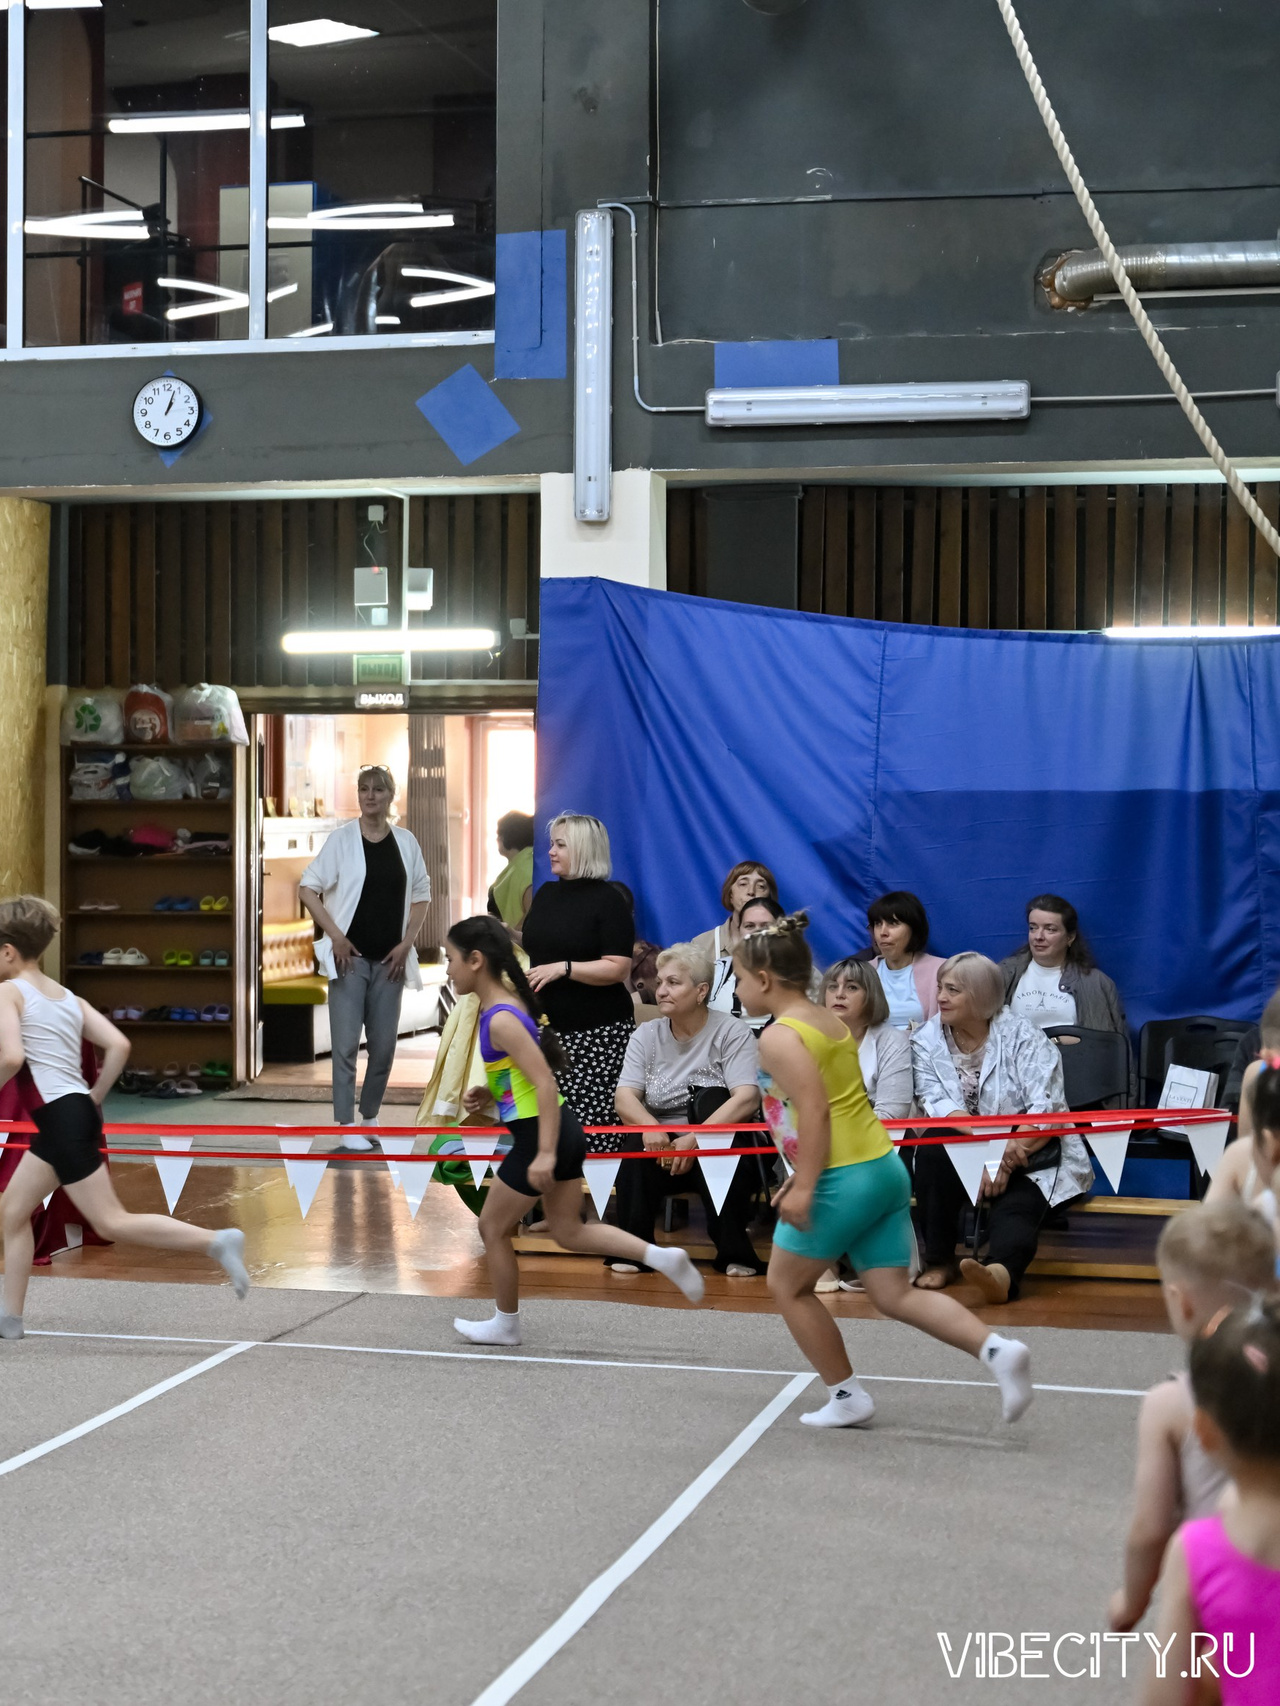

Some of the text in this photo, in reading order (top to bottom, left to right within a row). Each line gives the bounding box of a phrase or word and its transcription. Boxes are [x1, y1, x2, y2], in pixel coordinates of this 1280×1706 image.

[152, 387, 160, 396] 11
[162, 383, 172, 392] 12
[144, 396, 154, 405] 10
[184, 395, 191, 404] 2
[140, 408, 148, 417] 9
[188, 406, 195, 415] 3
[144, 420, 152, 429] 8
[184, 419, 191, 427] 4
[153, 428, 160, 437] 7
[163, 432, 172, 440] 6
[176, 427, 183, 436] 5
[360, 693, 404, 705] ВЫХОД
[1049, 993, 1070, 1004] PARIS
